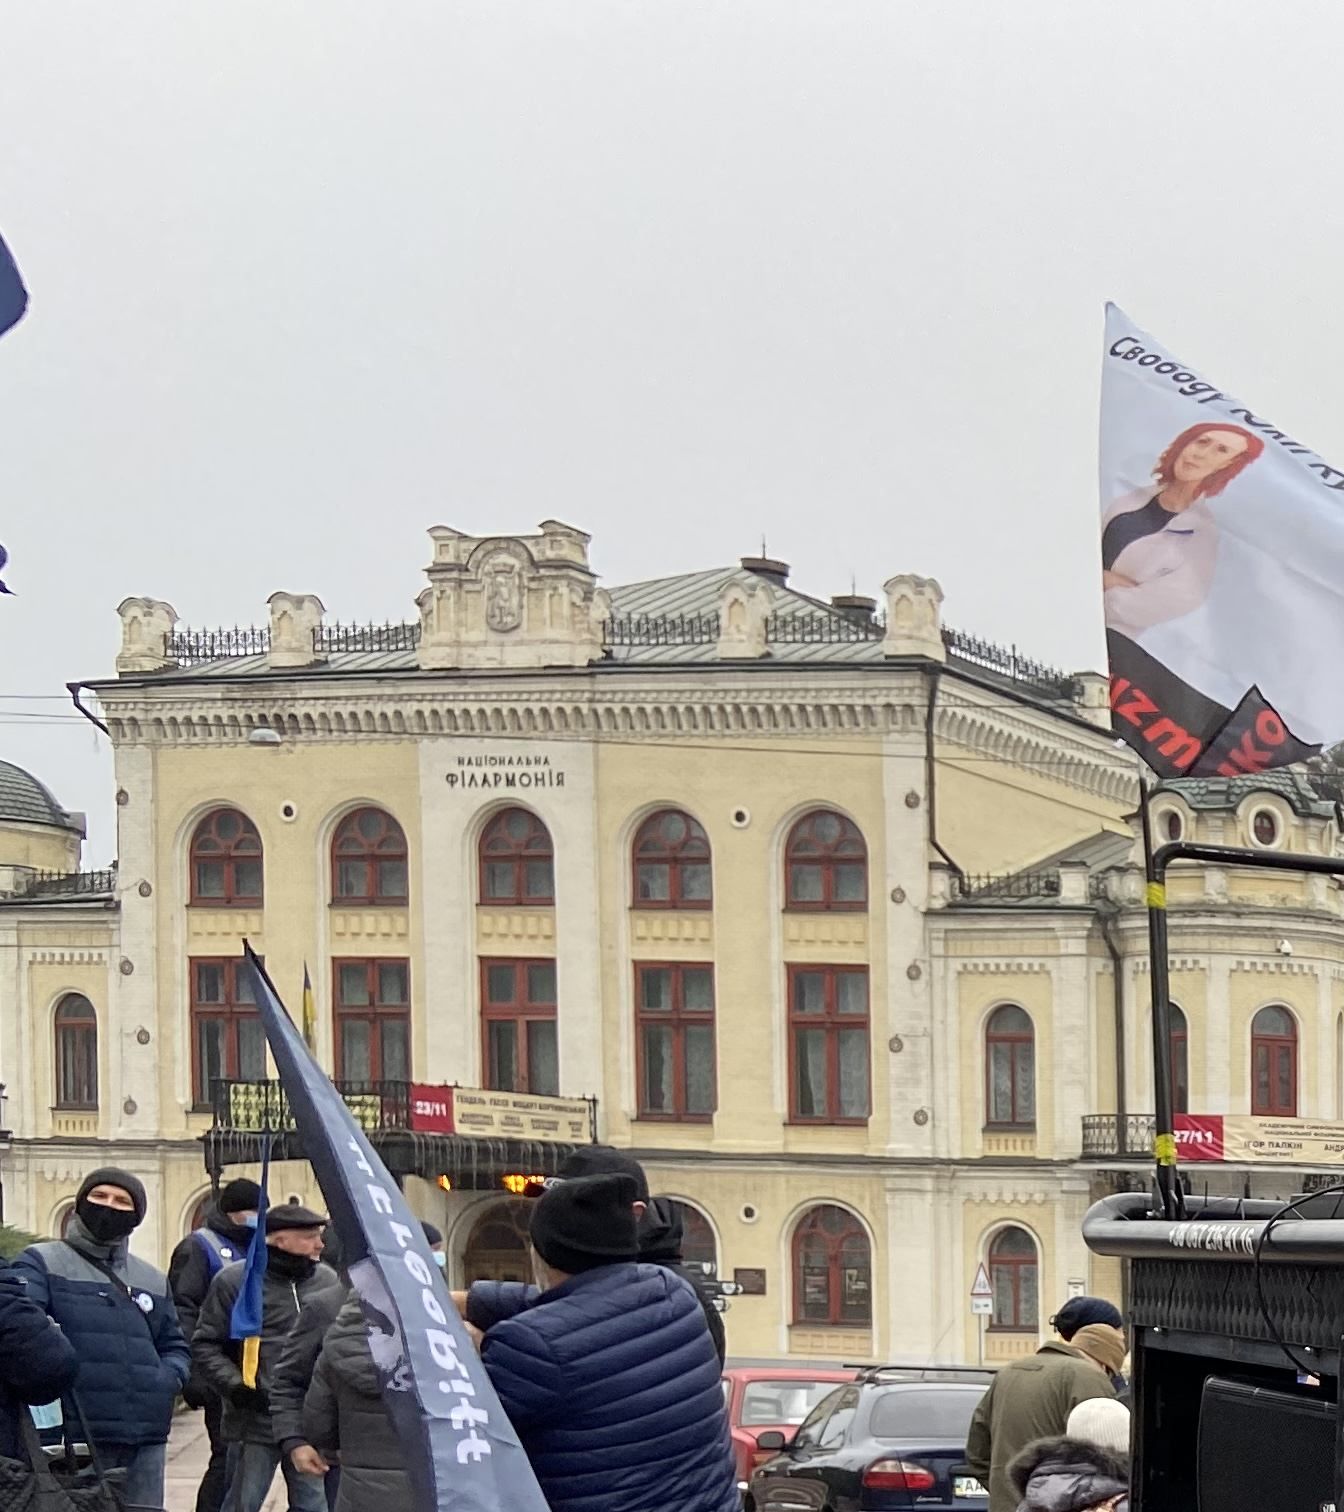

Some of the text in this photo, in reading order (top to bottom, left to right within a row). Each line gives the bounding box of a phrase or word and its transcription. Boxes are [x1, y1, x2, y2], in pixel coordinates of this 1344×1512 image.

[457, 755, 551, 767] НАЦІОНАЛЬНА
[445, 769, 565, 788] ФІЛАРМОНІЯ
[415, 1101, 447, 1117] 23/11
[1173, 1130, 1214, 1144] 27/11
